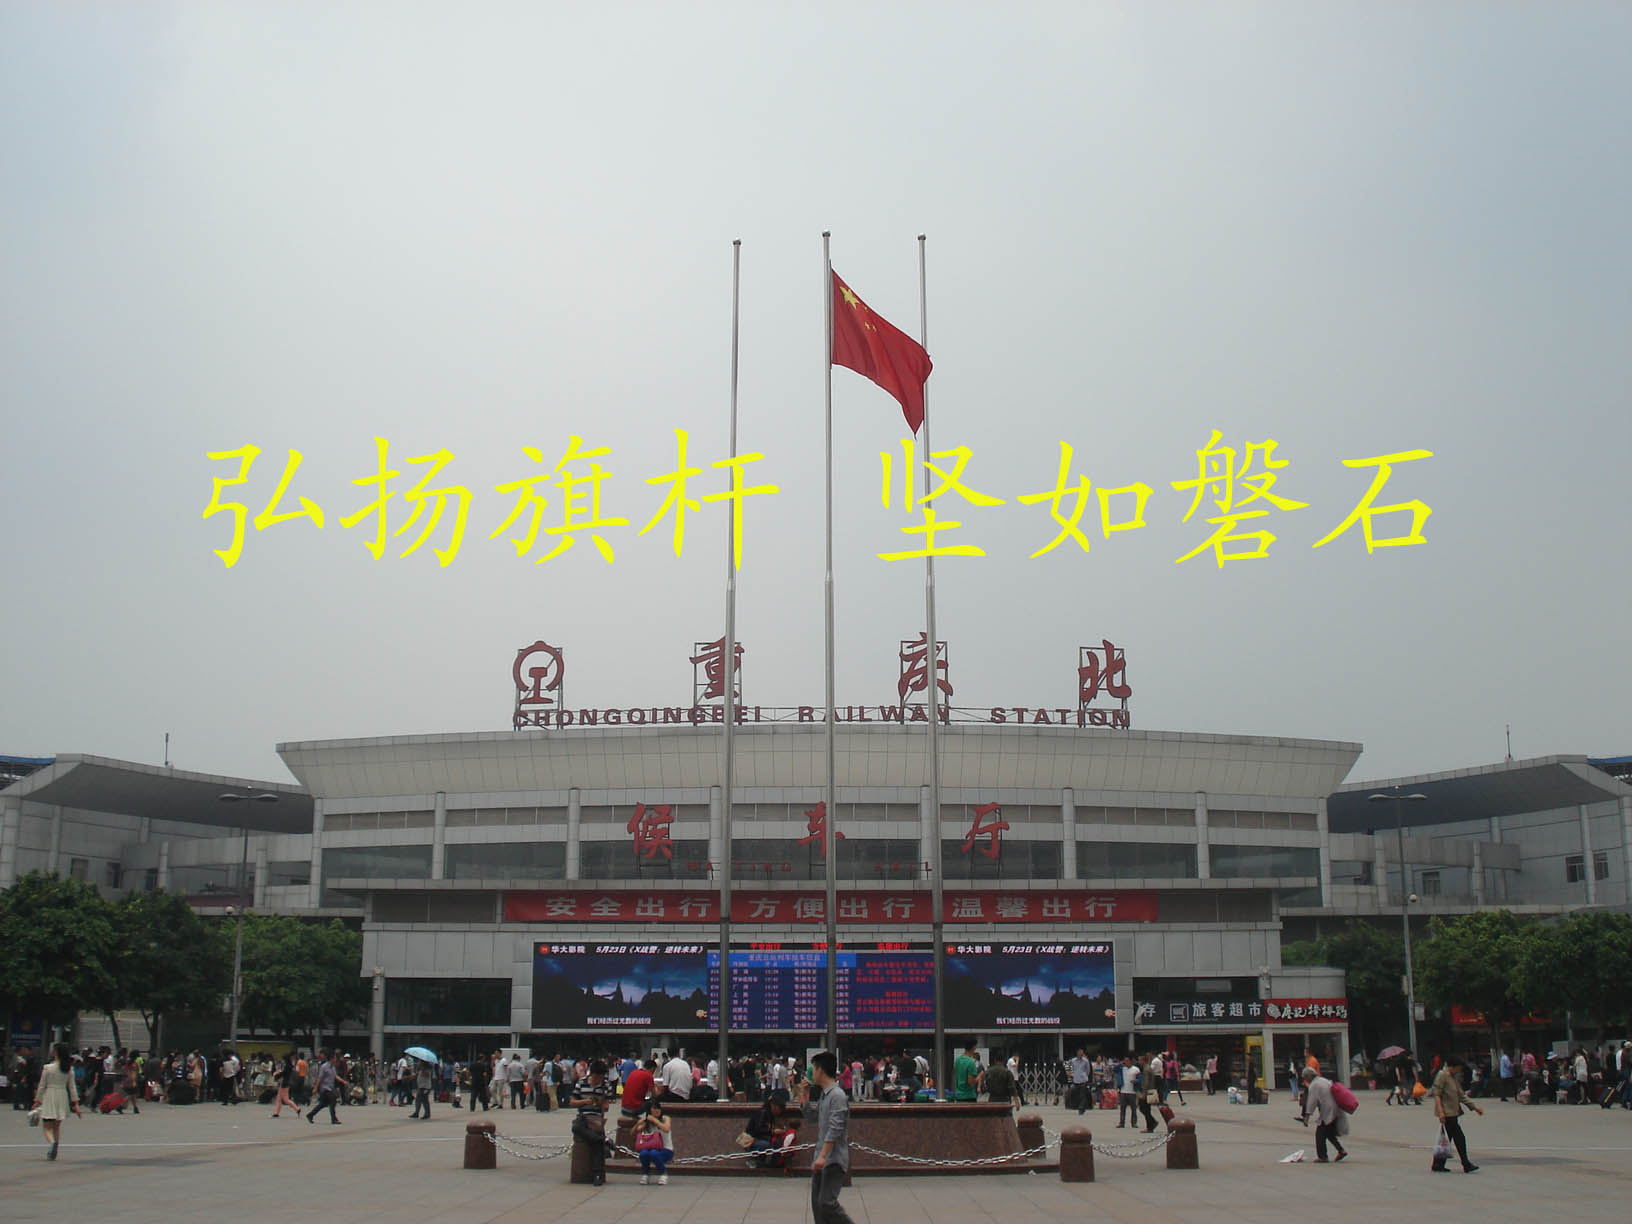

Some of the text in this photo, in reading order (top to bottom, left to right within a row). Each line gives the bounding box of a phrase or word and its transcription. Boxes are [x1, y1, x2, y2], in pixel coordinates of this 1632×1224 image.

[513, 706, 760, 728] CHONGQINGBEI
[990, 707, 1131, 727] STATION
[545, 897, 1117, 918] 安全出行 方便出行 温馨出行
[551, 945, 585, 954] 华大影院
[957, 945, 992, 954] 华大影院
[1192, 1002, 1262, 1017] 旅客超市
